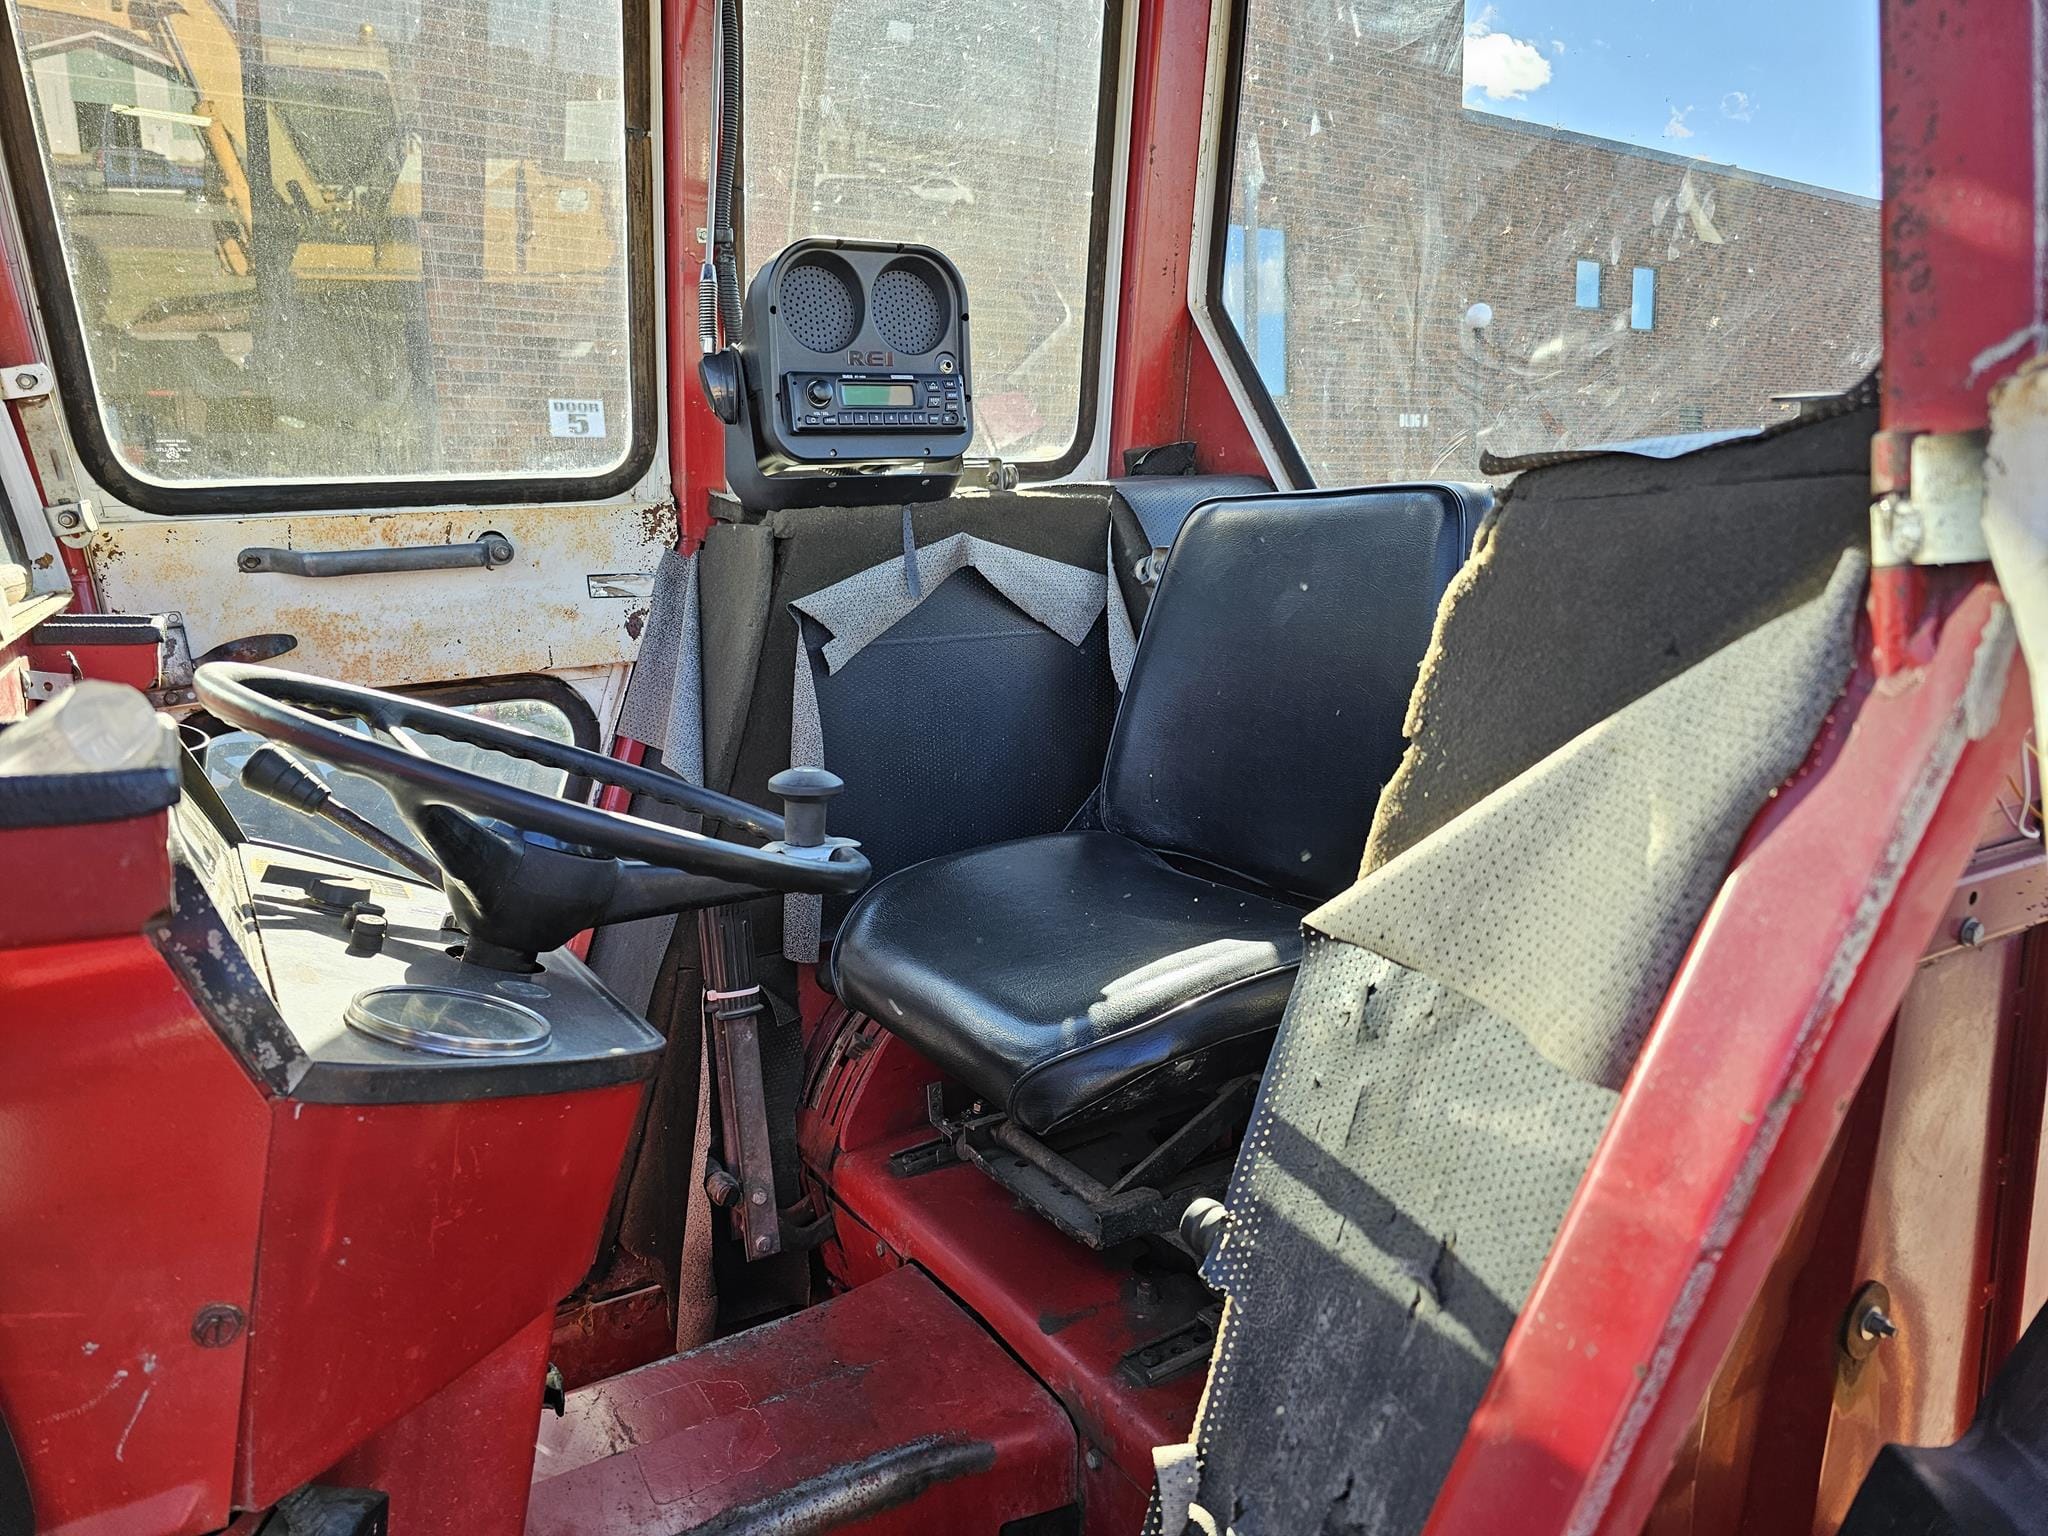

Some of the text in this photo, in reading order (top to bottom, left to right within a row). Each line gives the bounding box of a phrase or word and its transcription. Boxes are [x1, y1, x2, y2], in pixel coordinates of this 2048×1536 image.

[847, 350, 894, 367] REI
[553, 402, 599, 412] DOOR
[568, 413, 589, 435] 5
